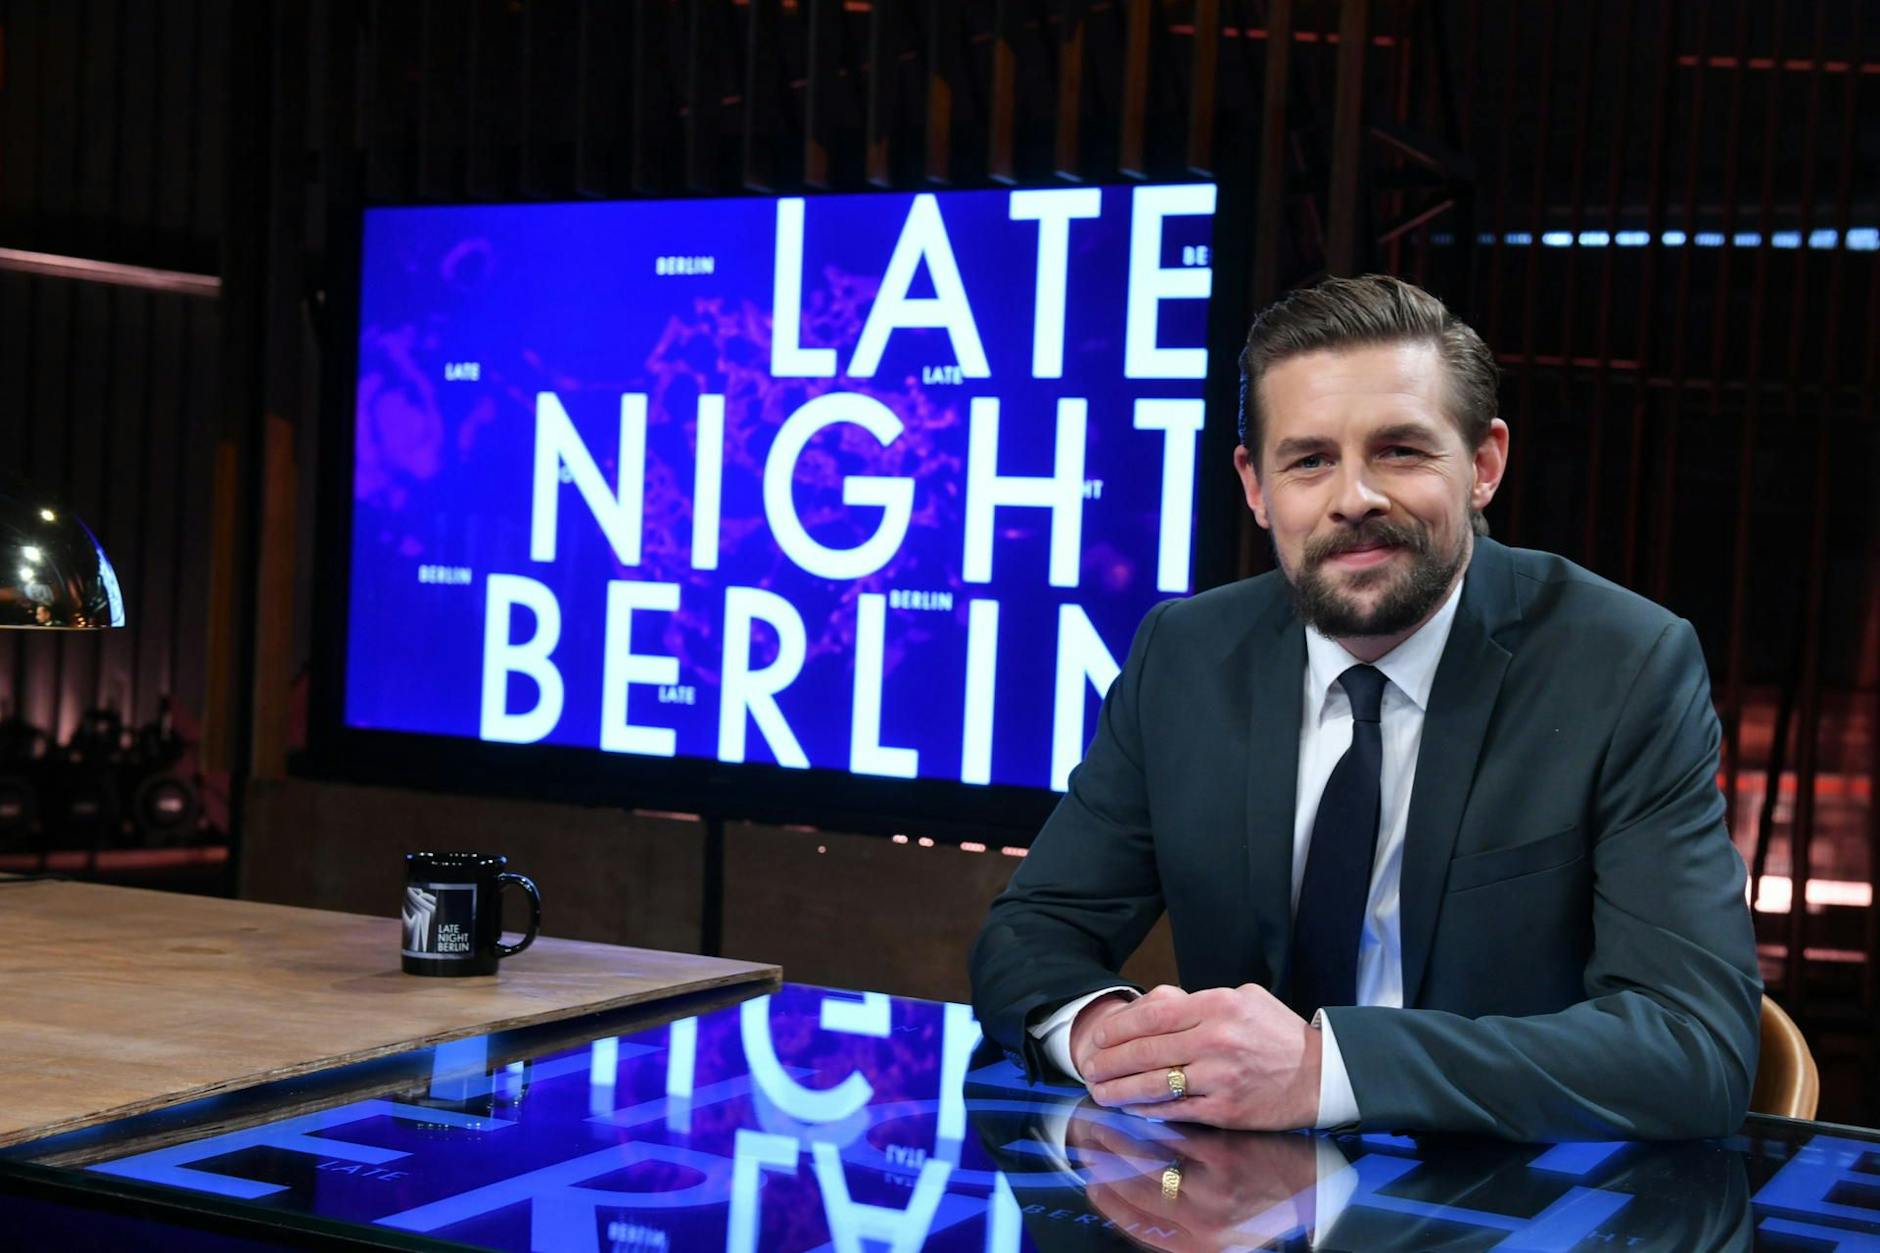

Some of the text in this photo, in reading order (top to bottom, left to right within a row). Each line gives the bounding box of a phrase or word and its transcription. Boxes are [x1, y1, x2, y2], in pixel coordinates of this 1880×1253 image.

[655, 256, 715, 276] BERLIN
[769, 183, 1218, 378] LATE
[444, 362, 481, 382] LATE
[923, 365, 963, 385] LATE
[529, 391, 1206, 593] NIGHT
[418, 564, 473, 585] BERLIN
[889, 589, 954, 611] BERLIN
[658, 685, 696, 705] LATE
[438, 924, 460, 934] LATE
[438, 933, 469, 943] NIGHT
[437, 942, 470, 952] BERLIN
[316, 1160, 409, 1182] LATE
[1021, 1203, 1179, 1240] BERLIN
